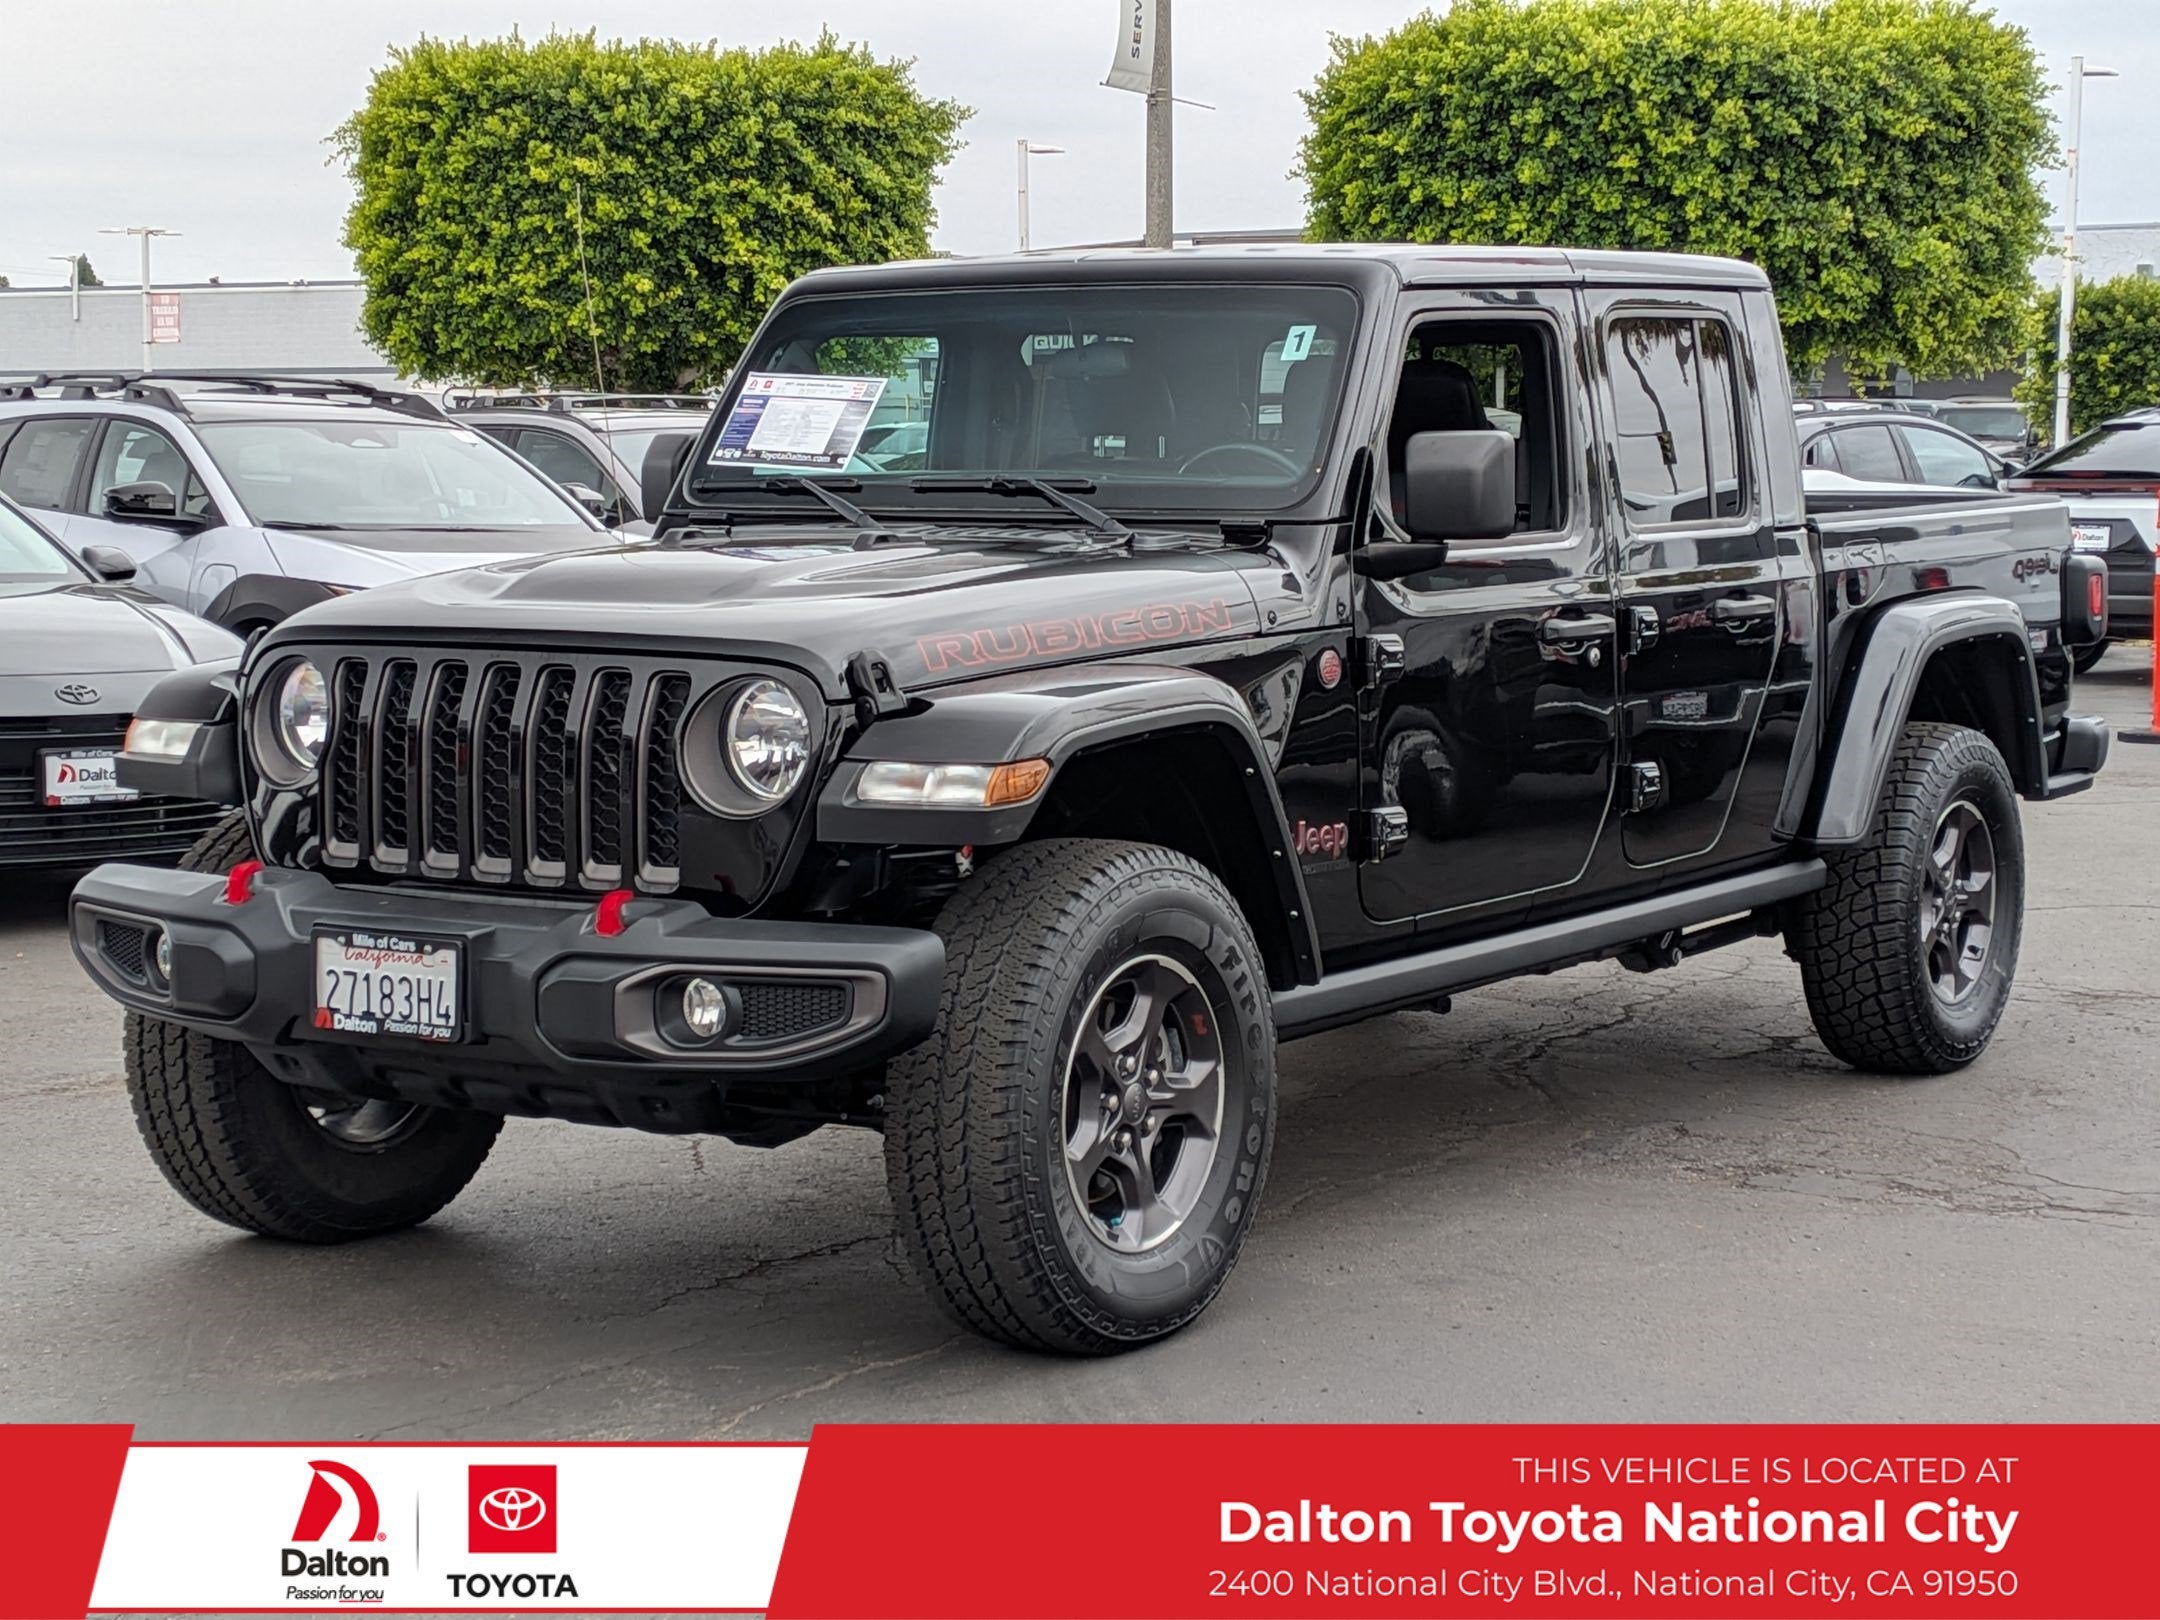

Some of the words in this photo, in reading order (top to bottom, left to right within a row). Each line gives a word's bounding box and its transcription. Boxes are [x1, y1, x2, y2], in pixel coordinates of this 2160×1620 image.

[1293, 331, 1306, 352] 1
[917, 600, 1232, 672] RUBICON
[79, 768, 117, 781] Dalto
[1296, 821, 1349, 859] Jeep
[352, 933, 375, 948] Mile
[376, 936, 389, 949] of
[389, 937, 416, 952] Cars
[344, 946, 434, 970] California
[326, 969, 451, 1025] 27183H4
[333, 1013, 377, 1034] Dalton
[432, 1026, 452, 1038] you
